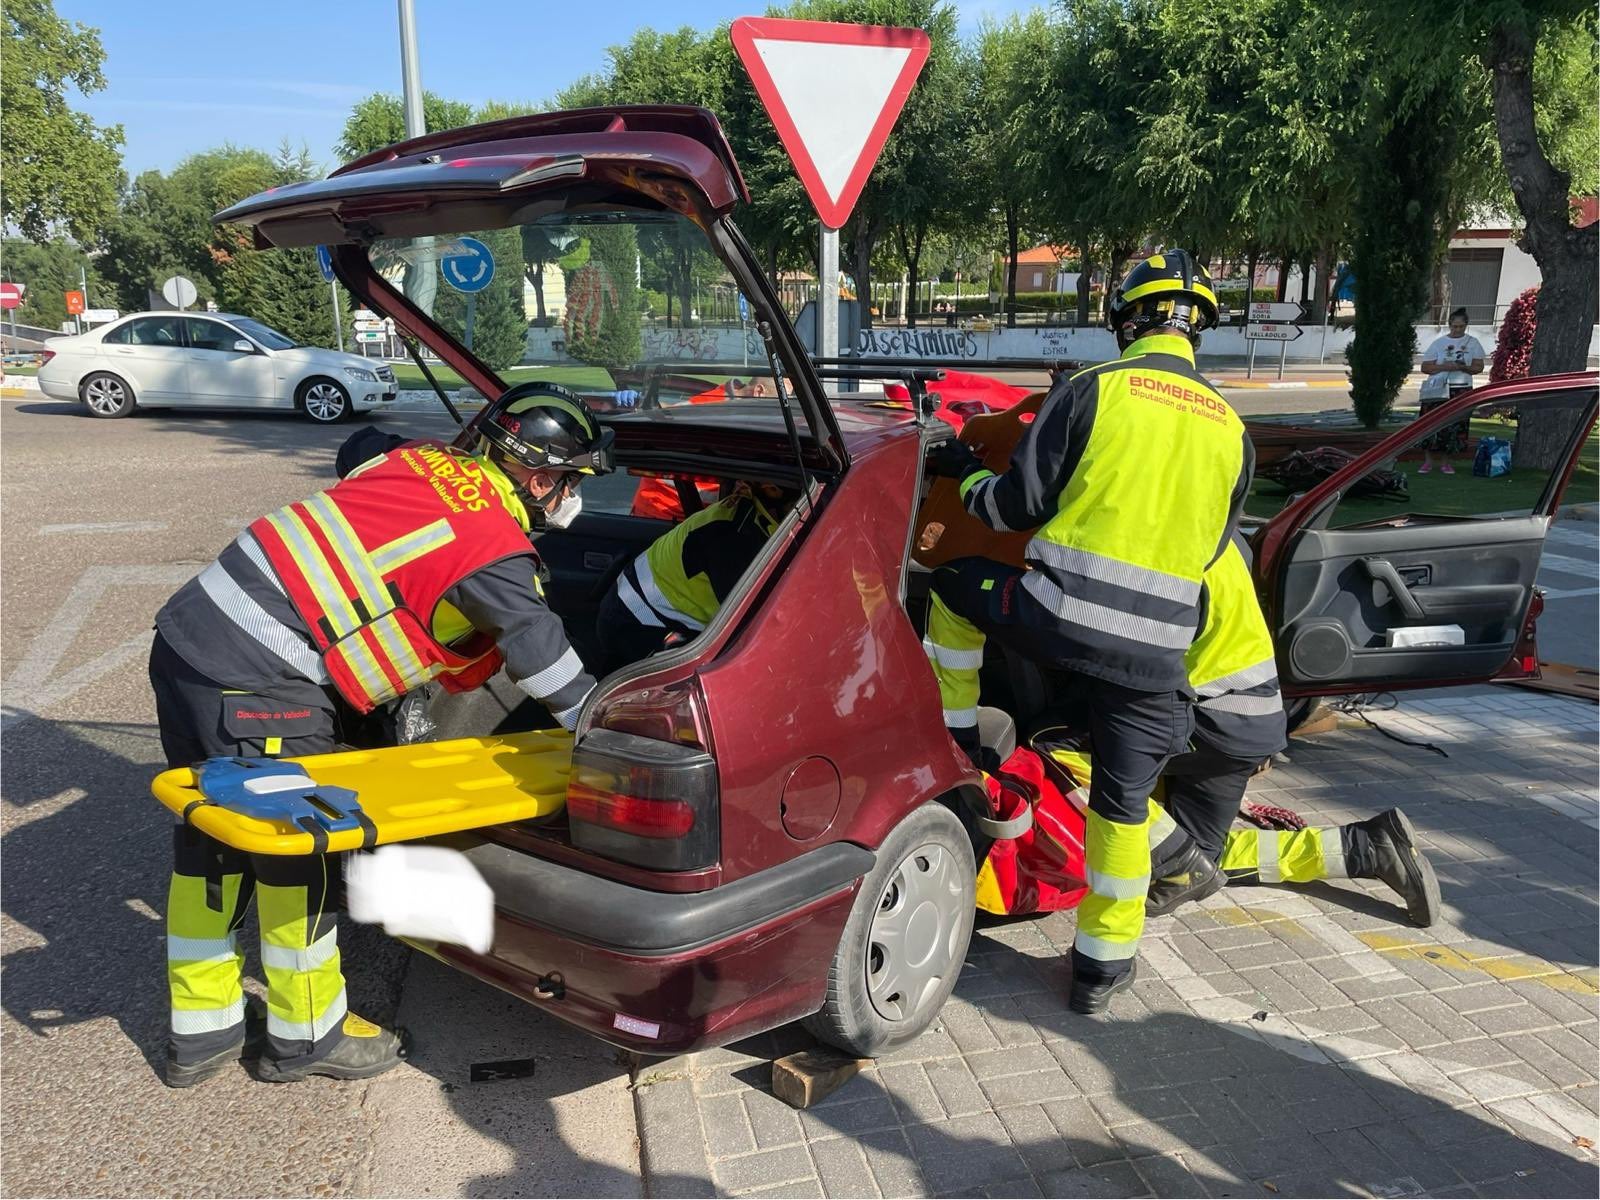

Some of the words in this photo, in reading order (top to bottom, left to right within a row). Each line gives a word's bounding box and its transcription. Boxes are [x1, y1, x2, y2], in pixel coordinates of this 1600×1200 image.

[1129, 376, 1226, 416] BOMBEROS
[1130, 388, 1175, 409] Diputación
[1175, 401, 1187, 412] de
[1190, 404, 1228, 426] Valladolid
[428, 475, 464, 513] Valladolid
[283, 709, 312, 719] Valladolid
